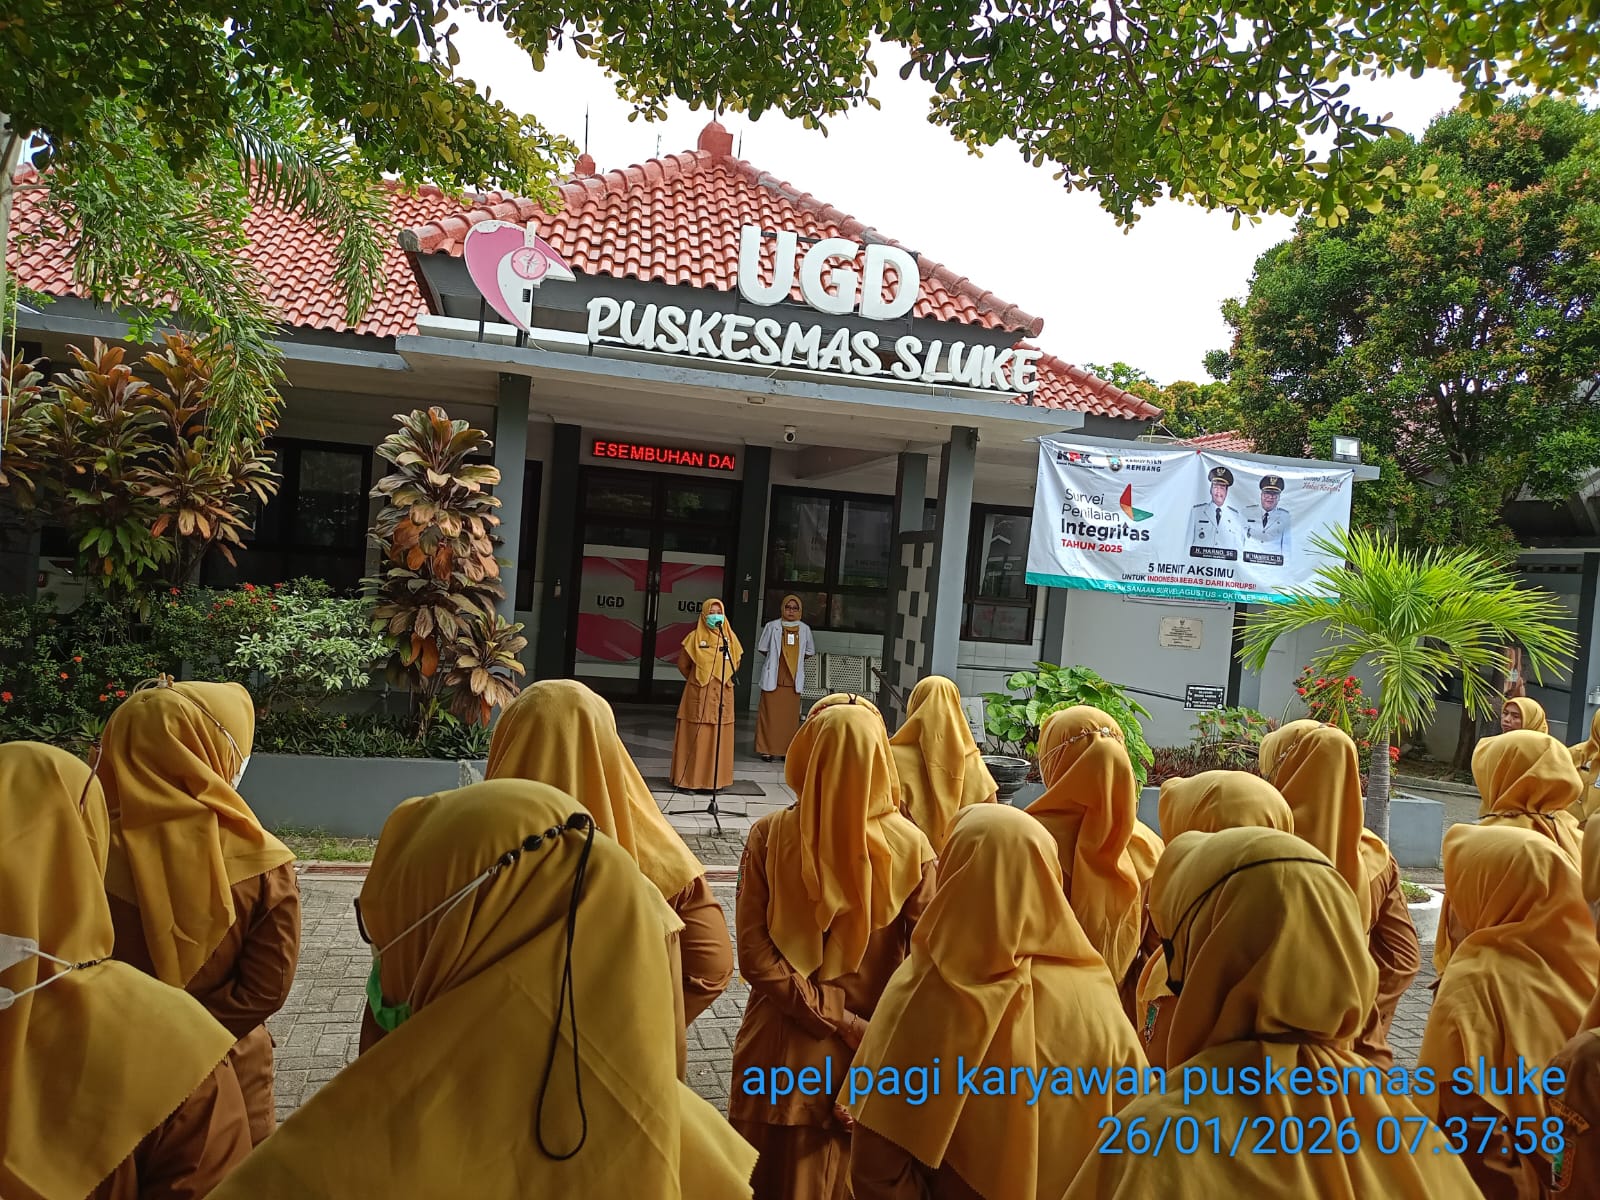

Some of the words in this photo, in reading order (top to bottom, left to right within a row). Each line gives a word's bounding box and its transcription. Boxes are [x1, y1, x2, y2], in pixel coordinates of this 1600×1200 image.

[738, 225, 920, 320] UGD
[587, 297, 882, 375] PUSKESMAS
[891, 336, 1043, 393] SLUKE
[593, 441, 703, 466] ESEMBUHAN
[1057, 451, 1092, 464] KPK
[1126, 464, 1161, 472] REMBANG
[1064, 488, 1105, 505] Survei
[1061, 503, 1120, 522] Penilaian
[1061, 518, 1150, 541] Integritas
[1061, 538, 1096, 551] TAHUN
[1098, 544, 1123, 553] 2025
[1148, 563, 1155, 572] 5
[1157, 563, 1185, 574] MENIT
[1187, 564, 1234, 578] AKSIMU
[1122, 573, 1147, 581] UNTUK
[1205, 578, 1224, 587] DARI
[597, 595, 625, 608] UGD
